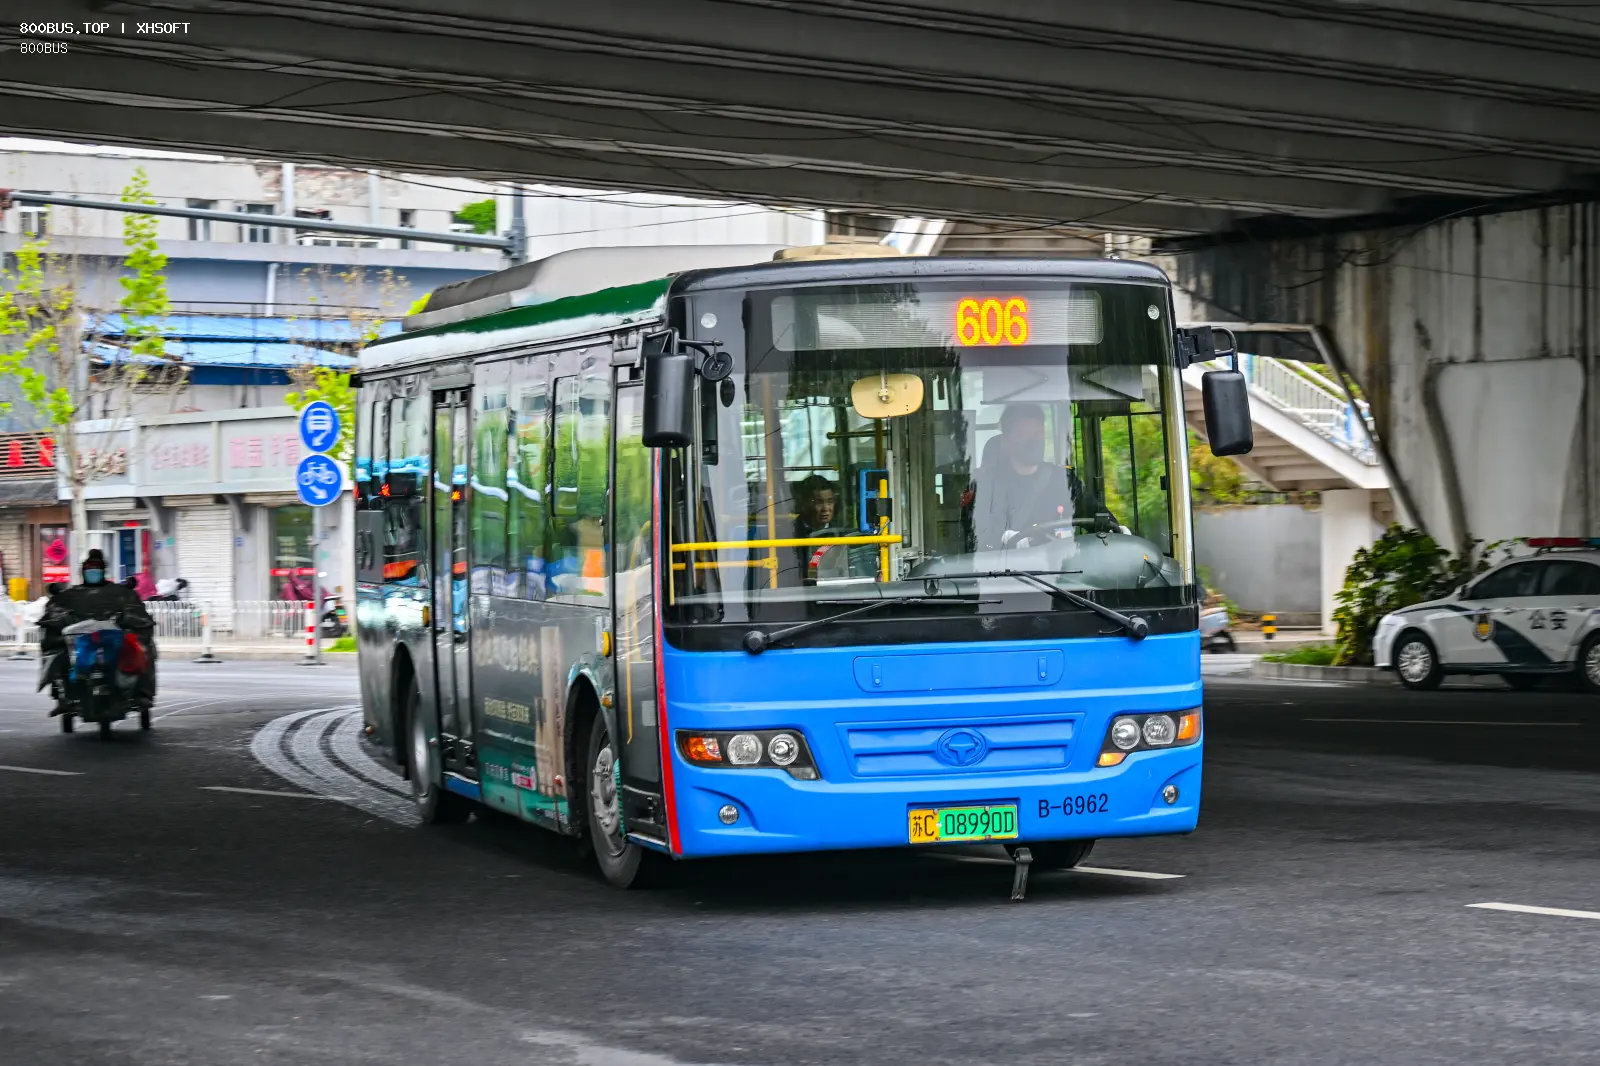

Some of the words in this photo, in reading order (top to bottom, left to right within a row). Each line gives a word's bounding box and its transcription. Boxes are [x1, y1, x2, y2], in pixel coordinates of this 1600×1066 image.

[956, 297, 1028, 346] 606
[1528, 609, 1568, 630] 公安
[1038, 793, 1109, 818] B-6962
